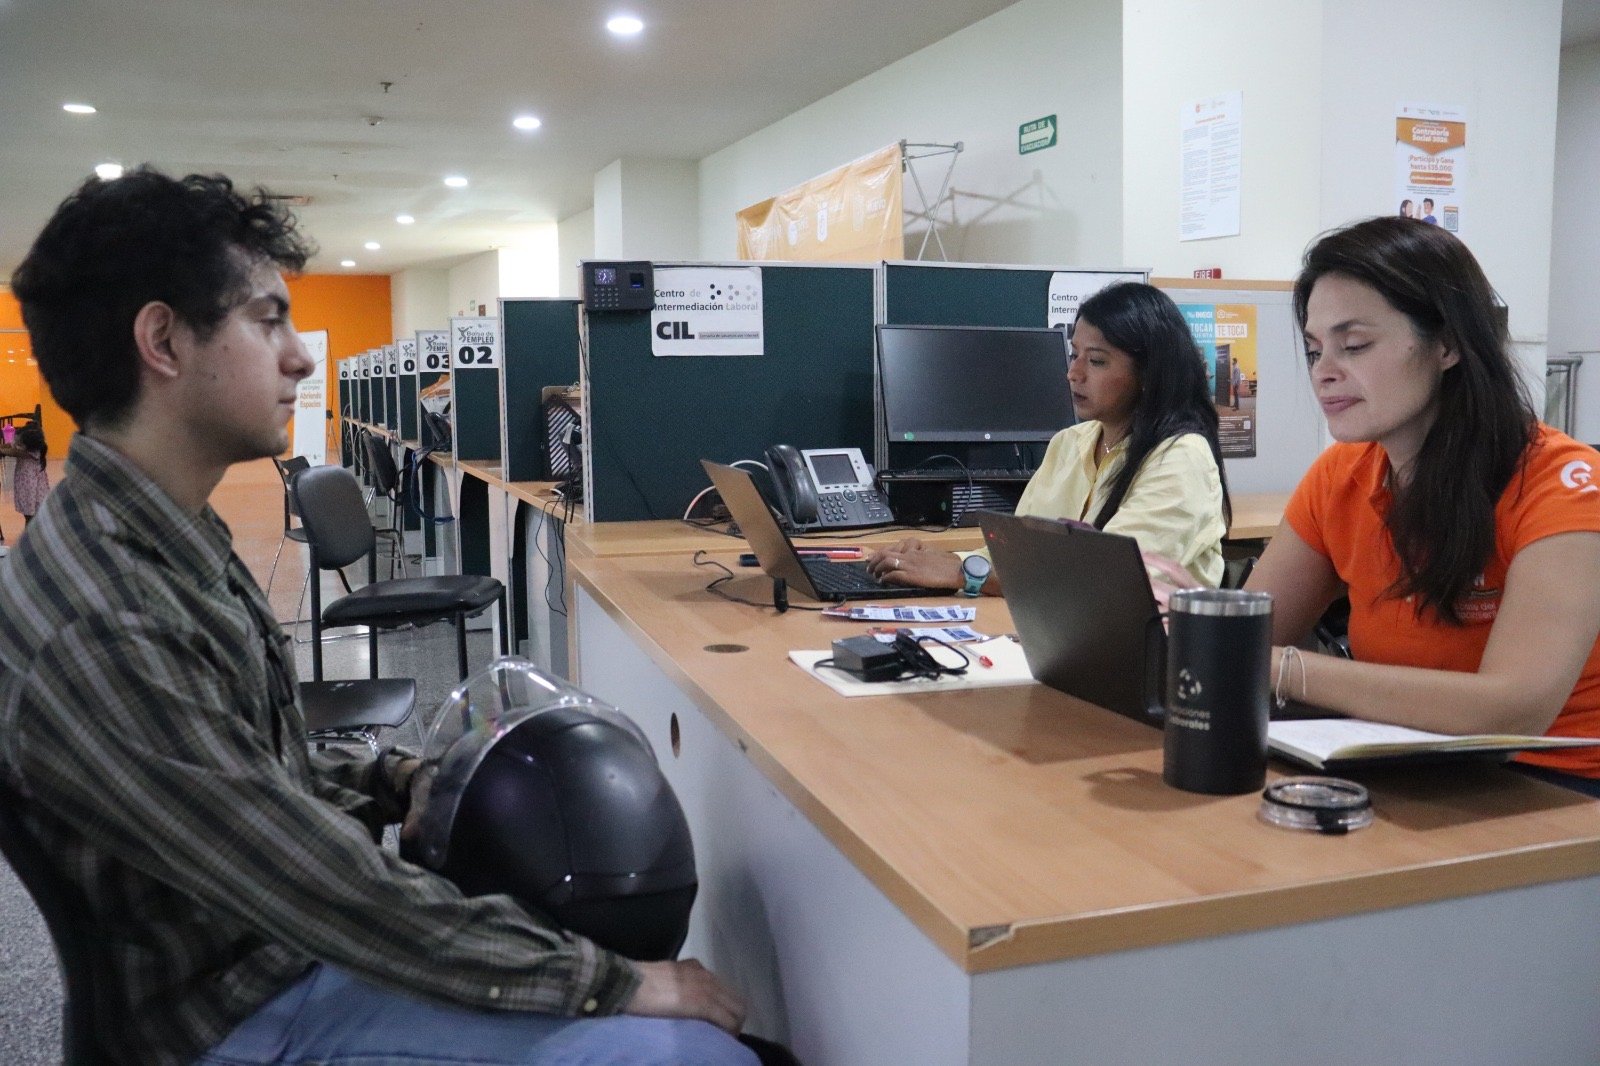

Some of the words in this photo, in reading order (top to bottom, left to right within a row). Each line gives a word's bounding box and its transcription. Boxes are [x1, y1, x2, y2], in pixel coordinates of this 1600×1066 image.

[1023, 123, 1037, 134] RUTA
[1037, 120, 1046, 129] DE
[1195, 270, 1211, 279] FIRE
[654, 289, 685, 298] Centro
[689, 289, 700, 298] de
[1051, 293, 1078, 301] Centro
[654, 302, 724, 311] Intermediación
[726, 302, 758, 311] Laboral
[1051, 306, 1078, 314] Interm
[656, 321, 695, 340] CIL
[1191, 323, 1213, 333] TOCAN
[1217, 325, 1227, 336] TE
[1228, 325, 1245, 337] TOCA
[458, 346, 493, 364] 02
[373, 365, 382, 375] 0
[403, 359, 415, 372] 0
